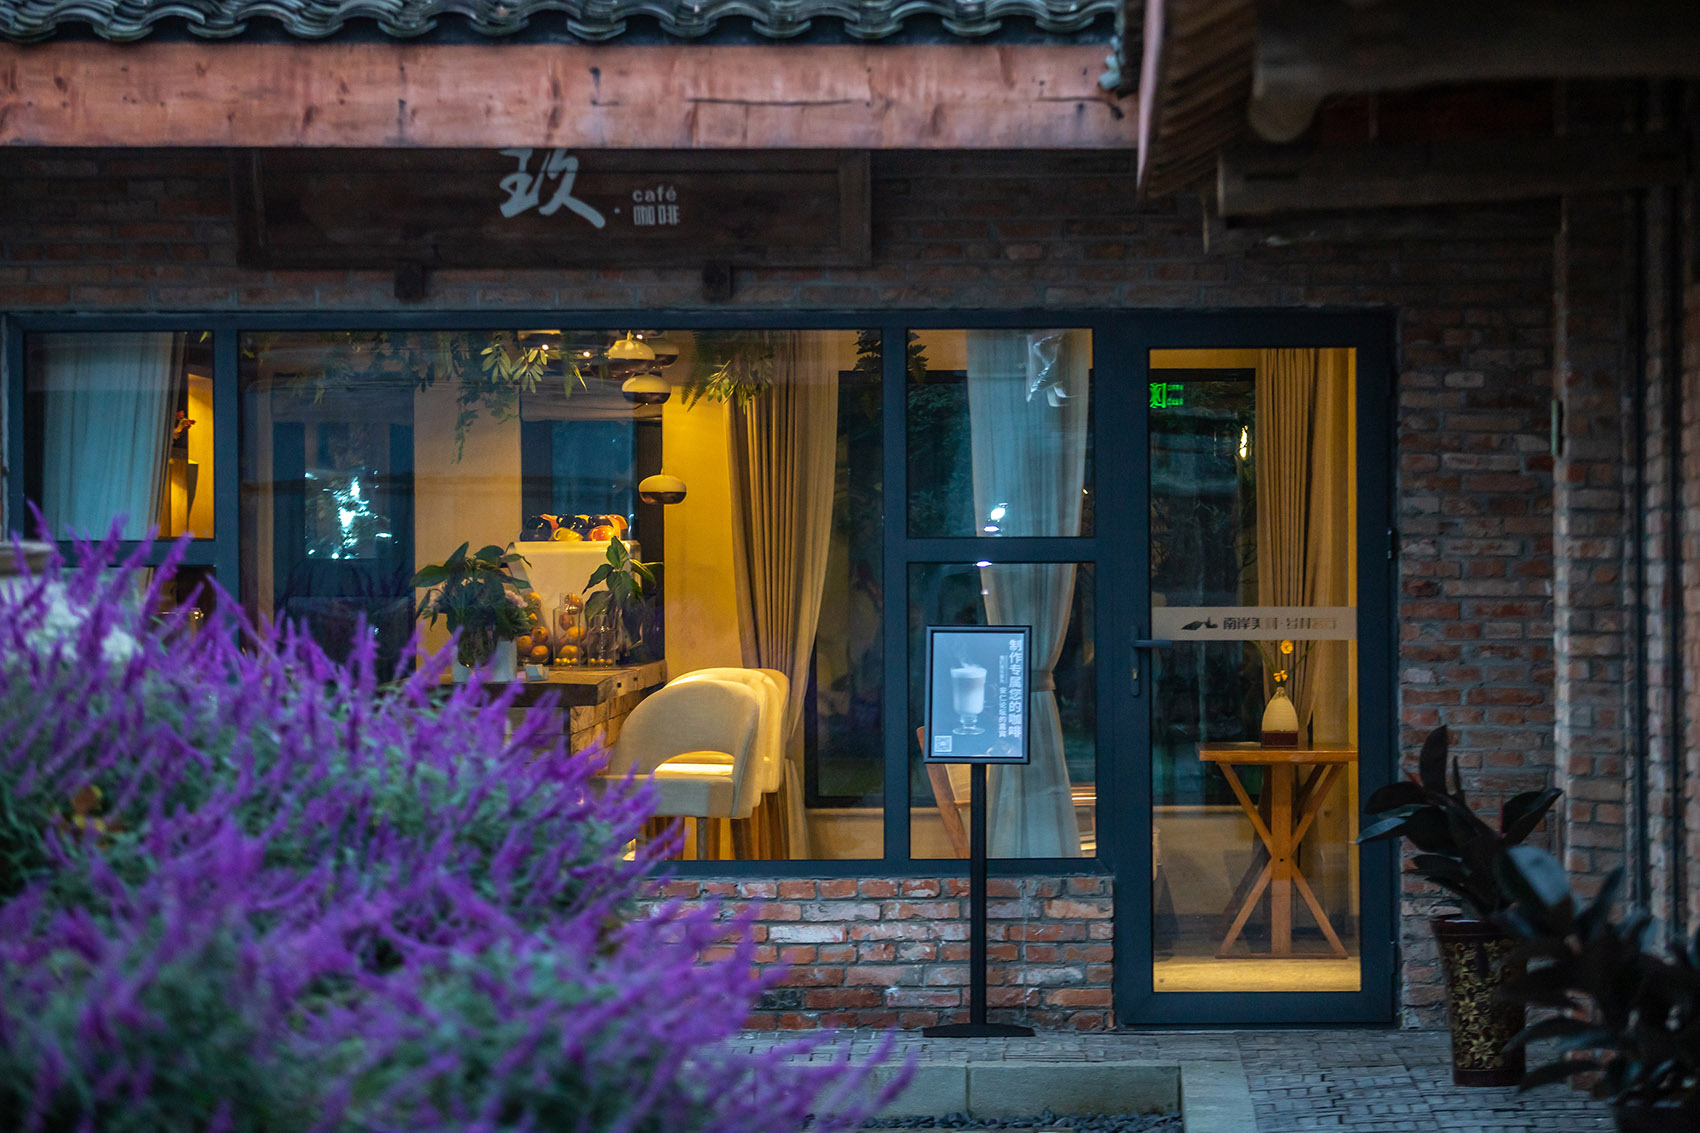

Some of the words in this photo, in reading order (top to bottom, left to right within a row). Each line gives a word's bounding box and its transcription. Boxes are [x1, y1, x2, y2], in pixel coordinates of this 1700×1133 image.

[632, 185, 677, 203] café
[633, 204, 681, 226] 咖啡
[1008, 639, 1022, 738] 制作专属您的咖啡
